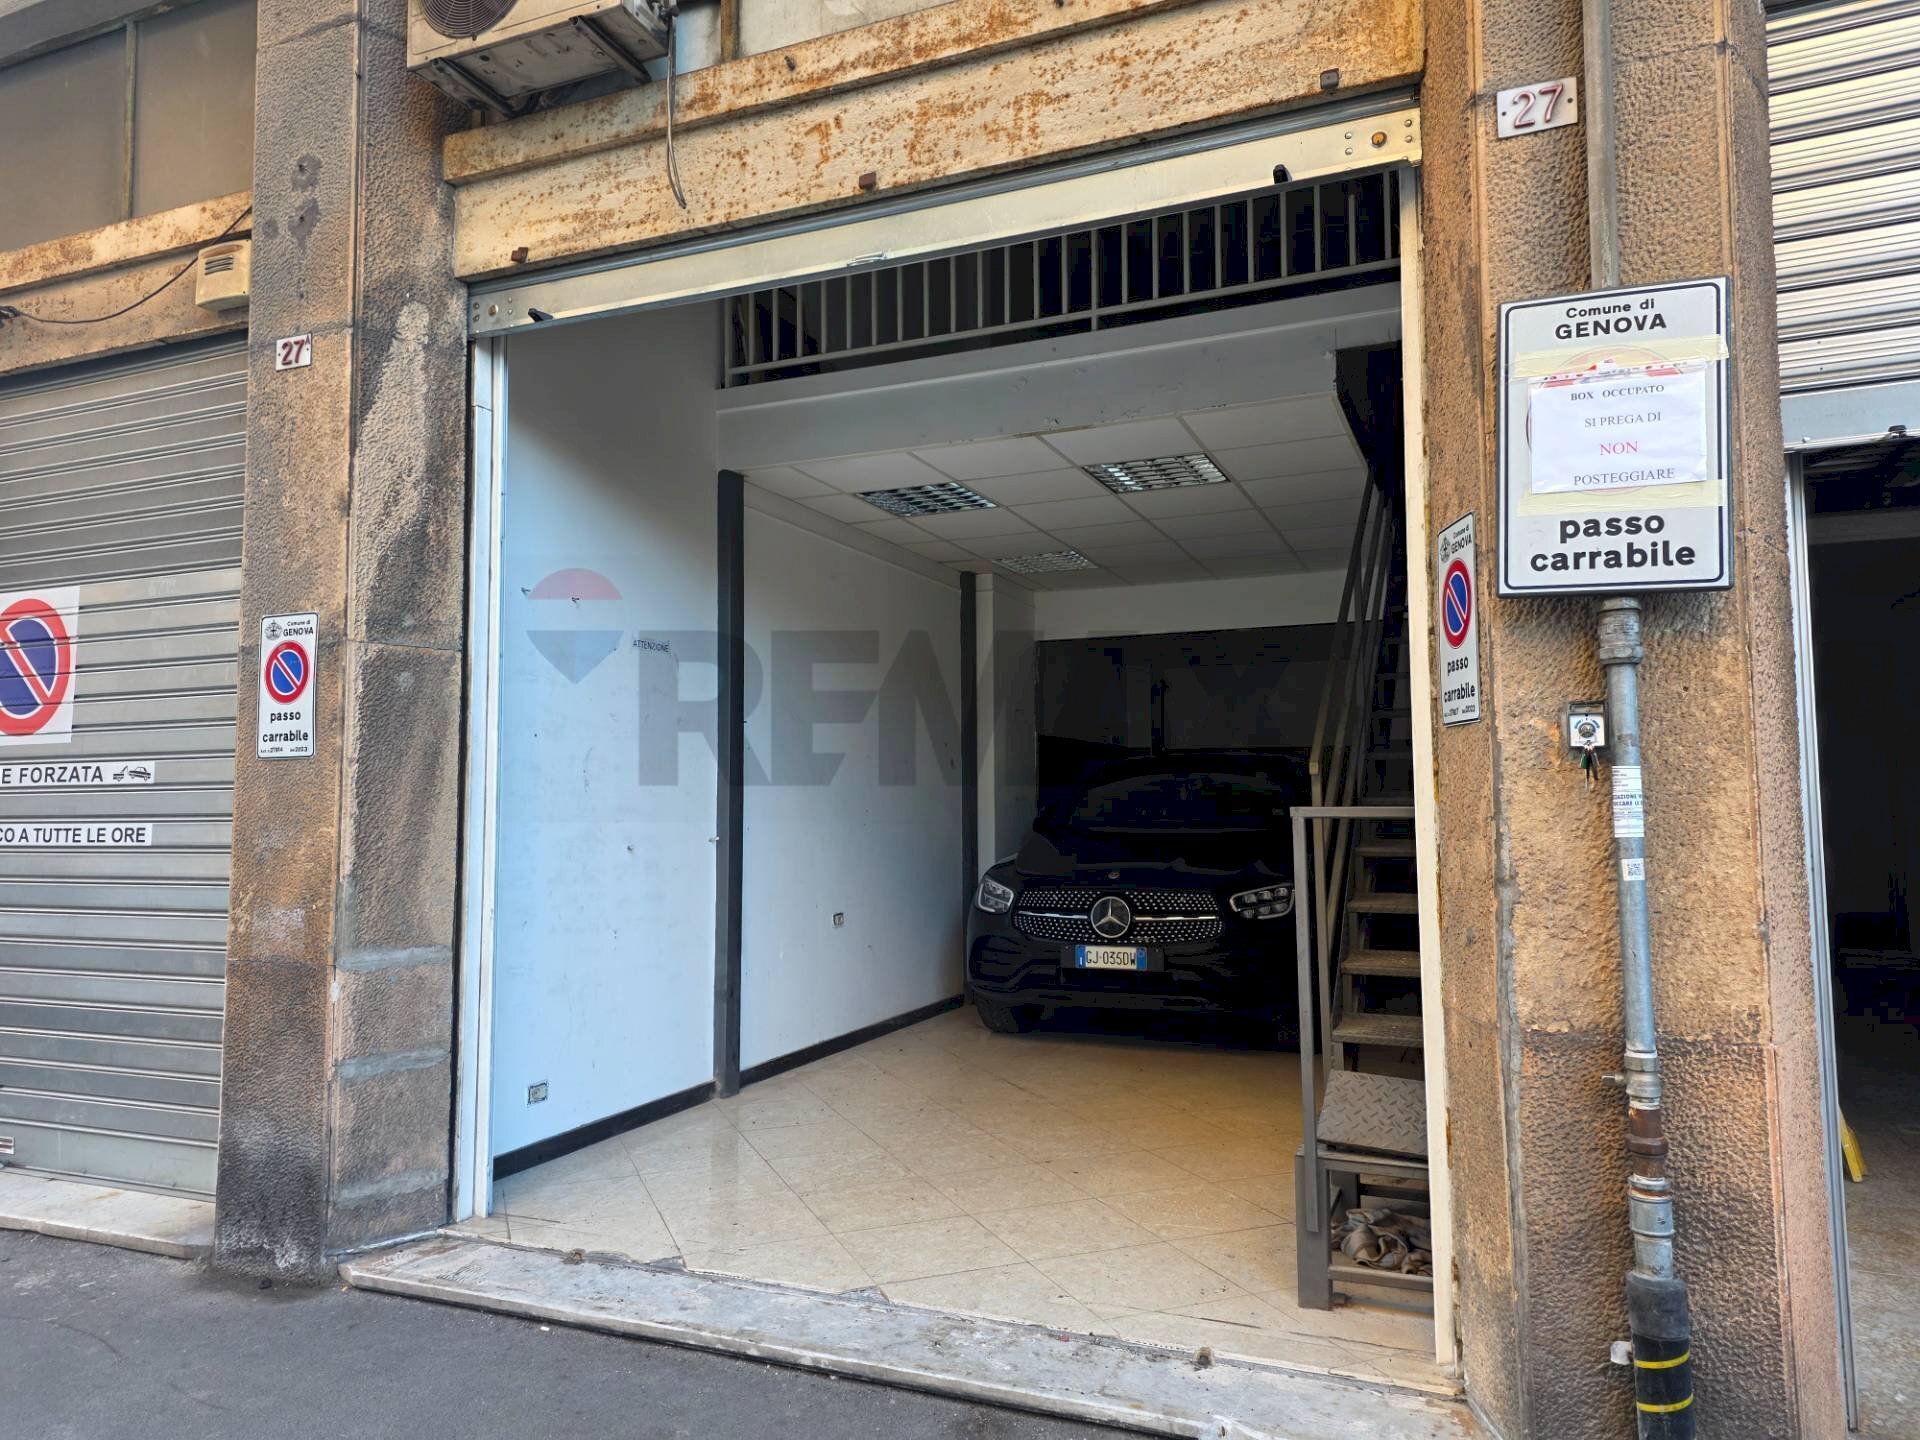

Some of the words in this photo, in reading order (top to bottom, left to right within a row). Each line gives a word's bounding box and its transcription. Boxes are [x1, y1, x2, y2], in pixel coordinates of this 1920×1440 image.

[1513, 84, 1563, 129] 27
[1566, 302, 1632, 319] Comune
[1639, 298, 1655, 311] di
[1555, 313, 1667, 339] GENOVA
[282, 340, 305, 365] 27
[1570, 391, 1594, 401] BOX
[1602, 385, 1665, 398] OCCUPATO
[1585, 418, 1597, 428] SI
[1600, 414, 1644, 427] PREGA
[1647, 412, 1662, 423] DI
[1600, 441, 1639, 456] NON
[1574, 468, 1676, 486] POSTEGGIARE
[1560, 515, 1665, 544] passo
[1451, 533, 1473, 554] GENOVA
[1530, 540, 1696, 572] carrabile
[283, 626, 314, 637] GENOVA
[1448, 655, 1469, 676] passo
[1444, 682, 1476, 703] carrabile
[270, 711, 301, 723] passo
[262, 729, 309, 742] carrabile
[19, 766, 104, 783] FORZATA
[18, 828, 29, 843] A
[33, 828, 82, 843] TUTTE
[87, 828, 107, 843] LE
[111, 827, 147, 843] ORE
